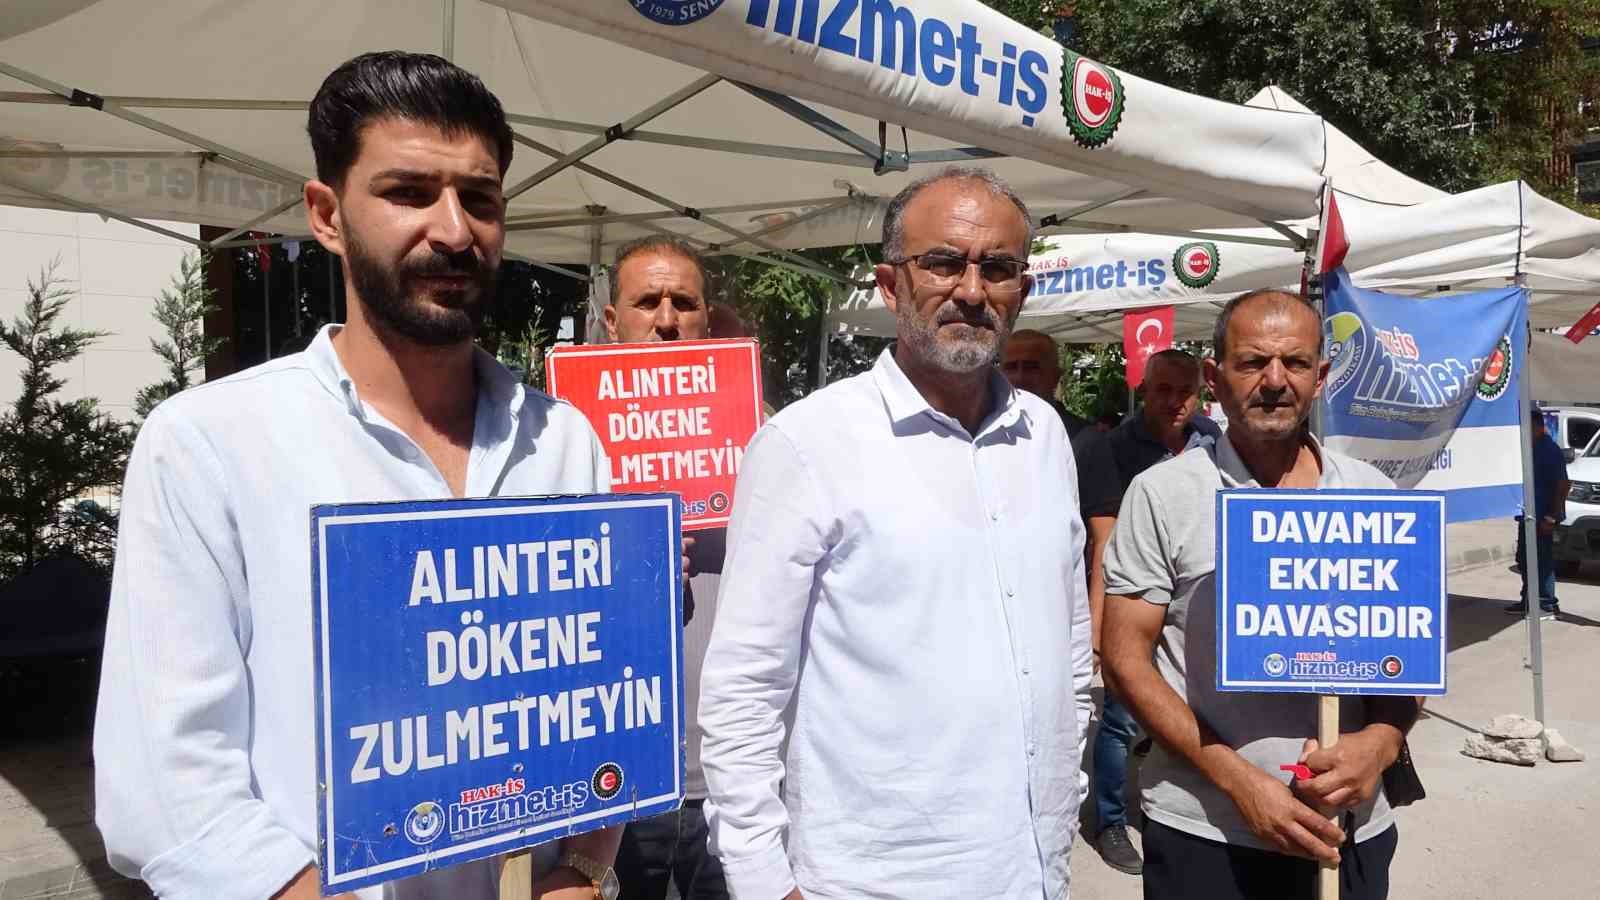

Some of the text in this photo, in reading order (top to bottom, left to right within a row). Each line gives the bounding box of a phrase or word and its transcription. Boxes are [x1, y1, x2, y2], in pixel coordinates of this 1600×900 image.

[598, 356, 716, 400] ALINTERİ
[608, 403, 712, 443] DÖKENE
[1252, 511, 1417, 544] DAVAMIZ
[408, 522, 612, 606] ALINTERİ
[1269, 557, 1399, 591] EKMEK
[1235, 603, 1433, 639] DAVASIDIR
[426, 610, 602, 687] DÖKENE
[349, 666, 662, 784] ZULMETMEYİN
[449, 781, 589, 834] hizmet-iş
